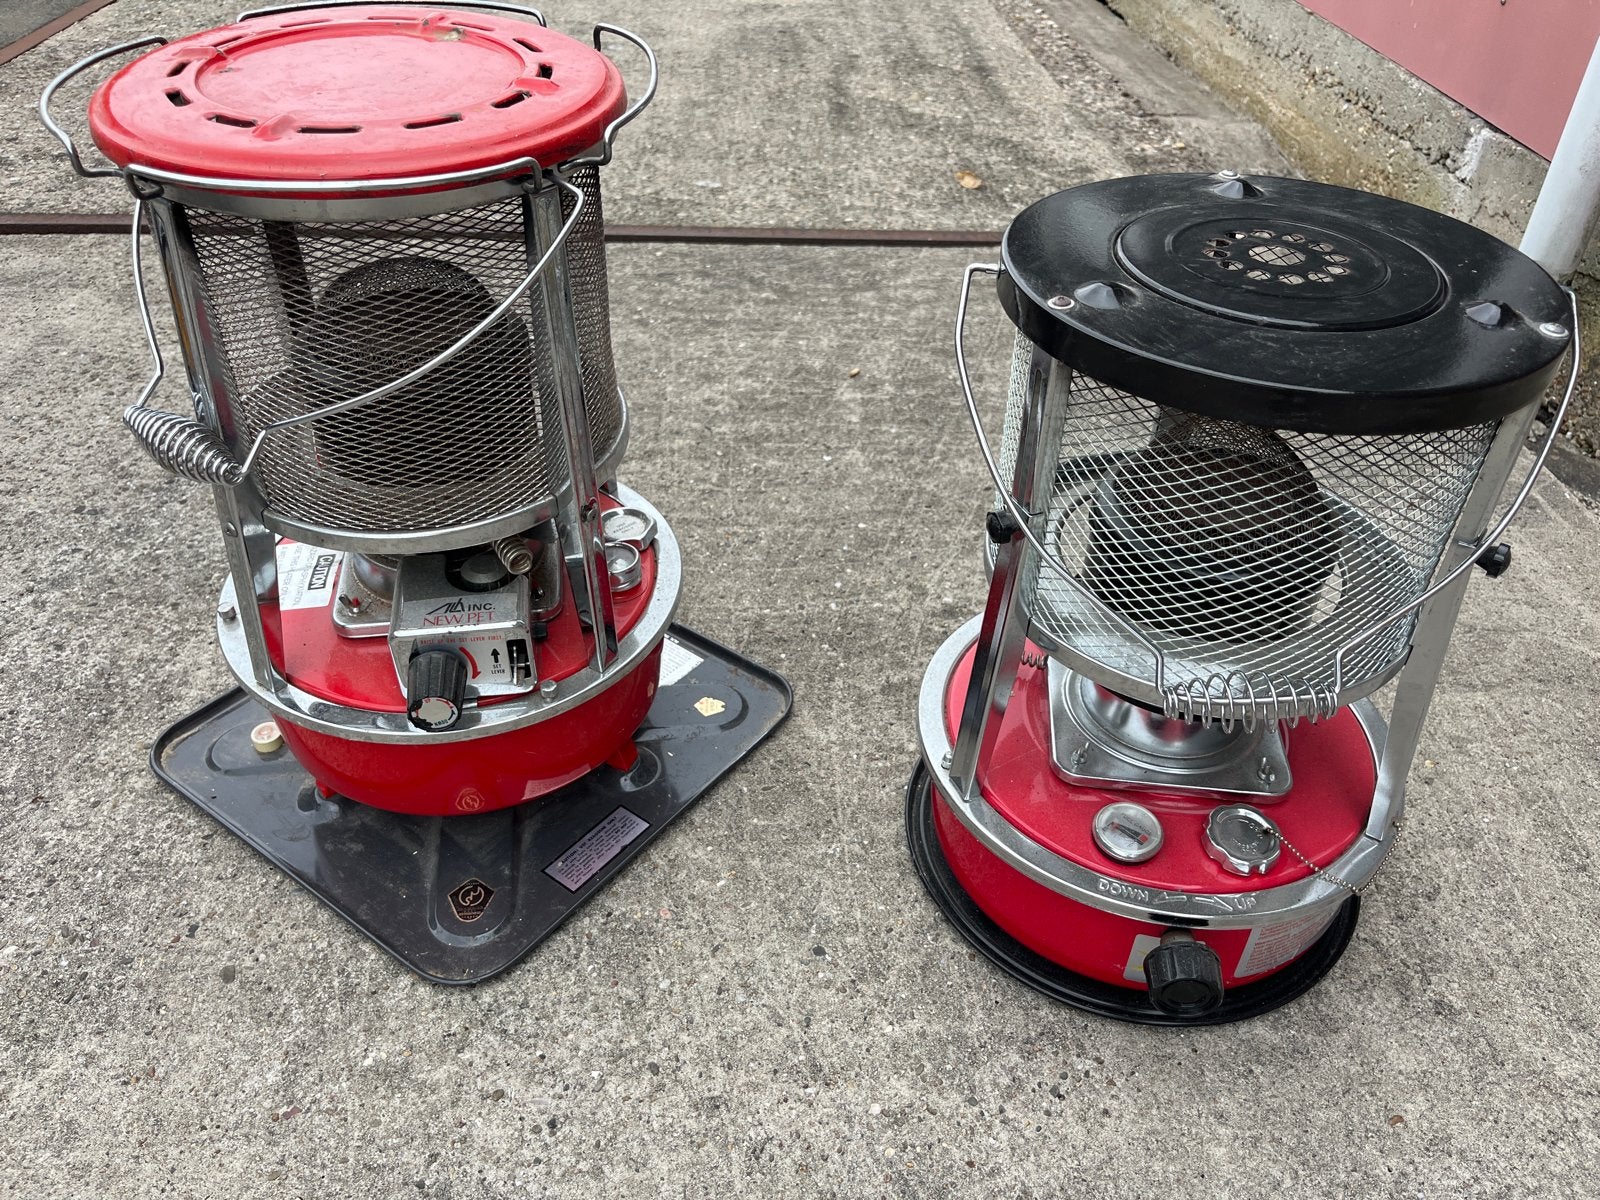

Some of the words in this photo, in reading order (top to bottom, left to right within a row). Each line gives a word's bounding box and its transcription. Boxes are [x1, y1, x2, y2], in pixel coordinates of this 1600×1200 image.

[468, 602, 496, 612] INC.
[423, 613, 464, 627] NEW
[467, 611, 495, 624] PET
[1099, 878, 1149, 901] DOWN
[1234, 897, 1257, 910] UP
